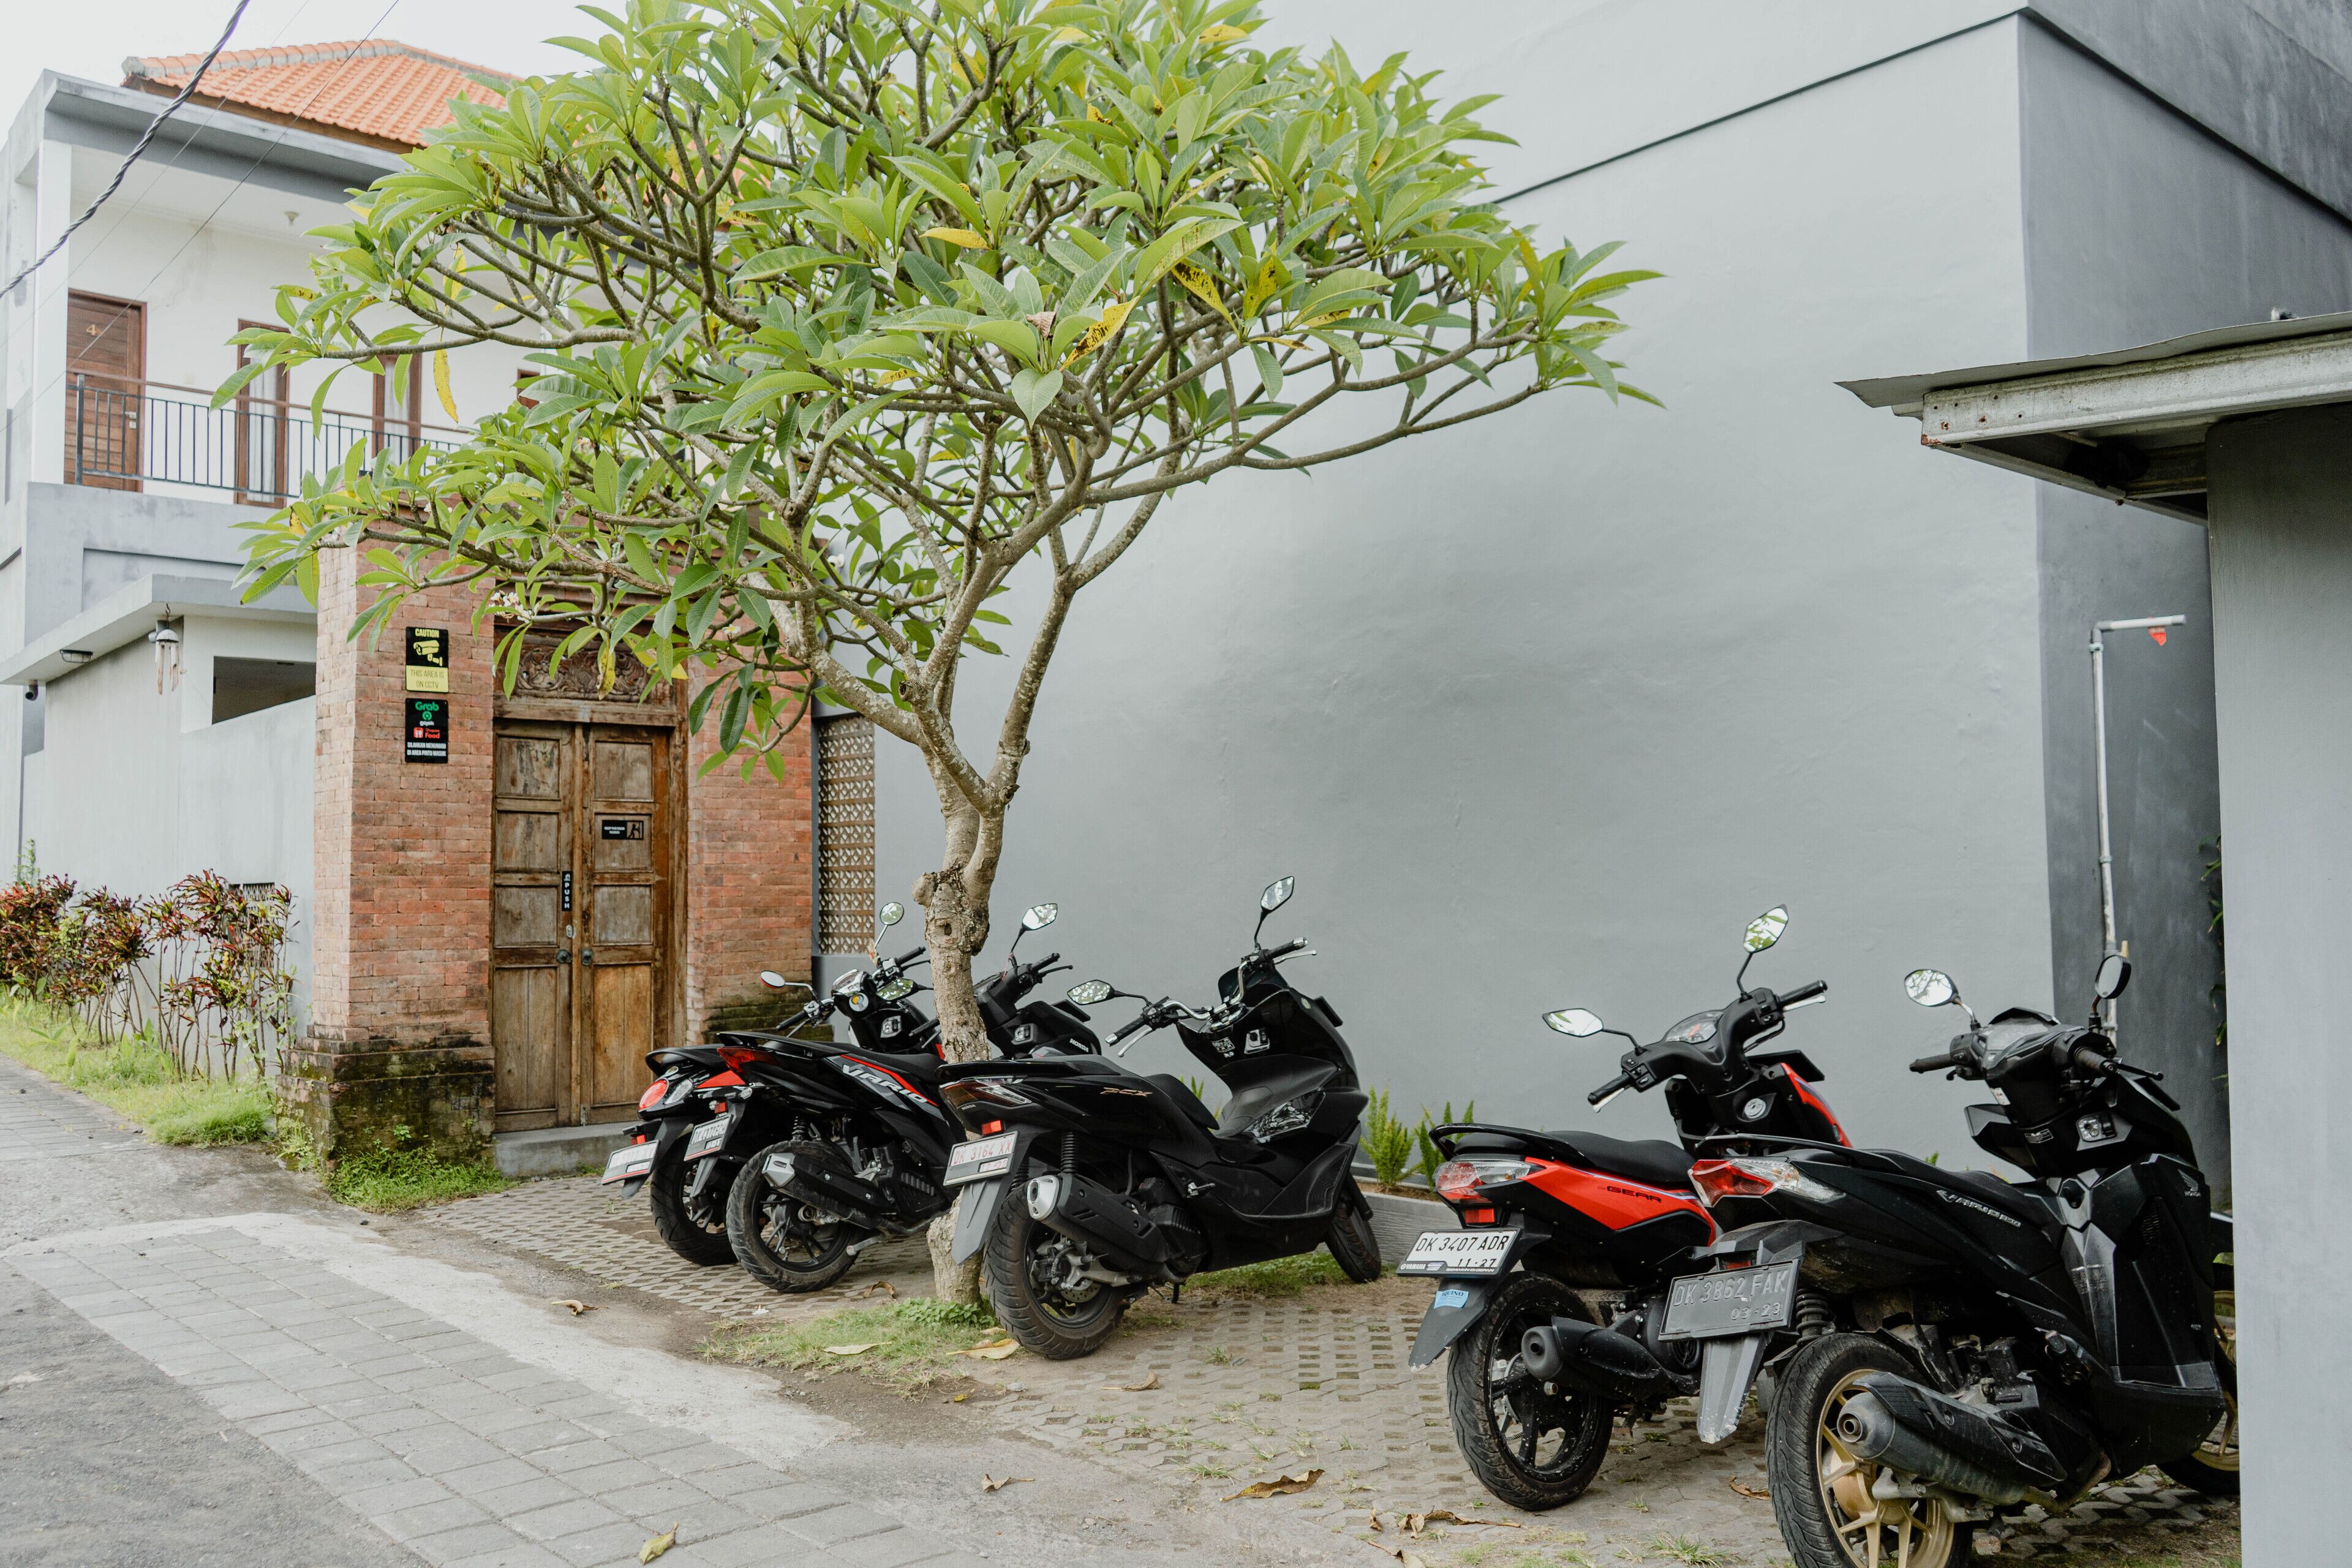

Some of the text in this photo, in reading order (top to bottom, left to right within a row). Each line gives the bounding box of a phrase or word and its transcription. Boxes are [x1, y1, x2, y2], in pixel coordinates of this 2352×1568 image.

[415, 628, 440, 638] CAUTION
[415, 701, 439, 711] Grab
[1069, 1038, 1089, 1052] HONDA
[842, 1065, 928, 1103] VARIO
[1100, 1087, 1153, 1097] PCX
[954, 1140, 1012, 1165] DK 3164 XX
[1607, 1186, 1662, 1203] GEAR
[1415, 1235, 1510, 1252] DK 3407 ADR
[1673, 1270, 1789, 1306] DK 3862 FAK
